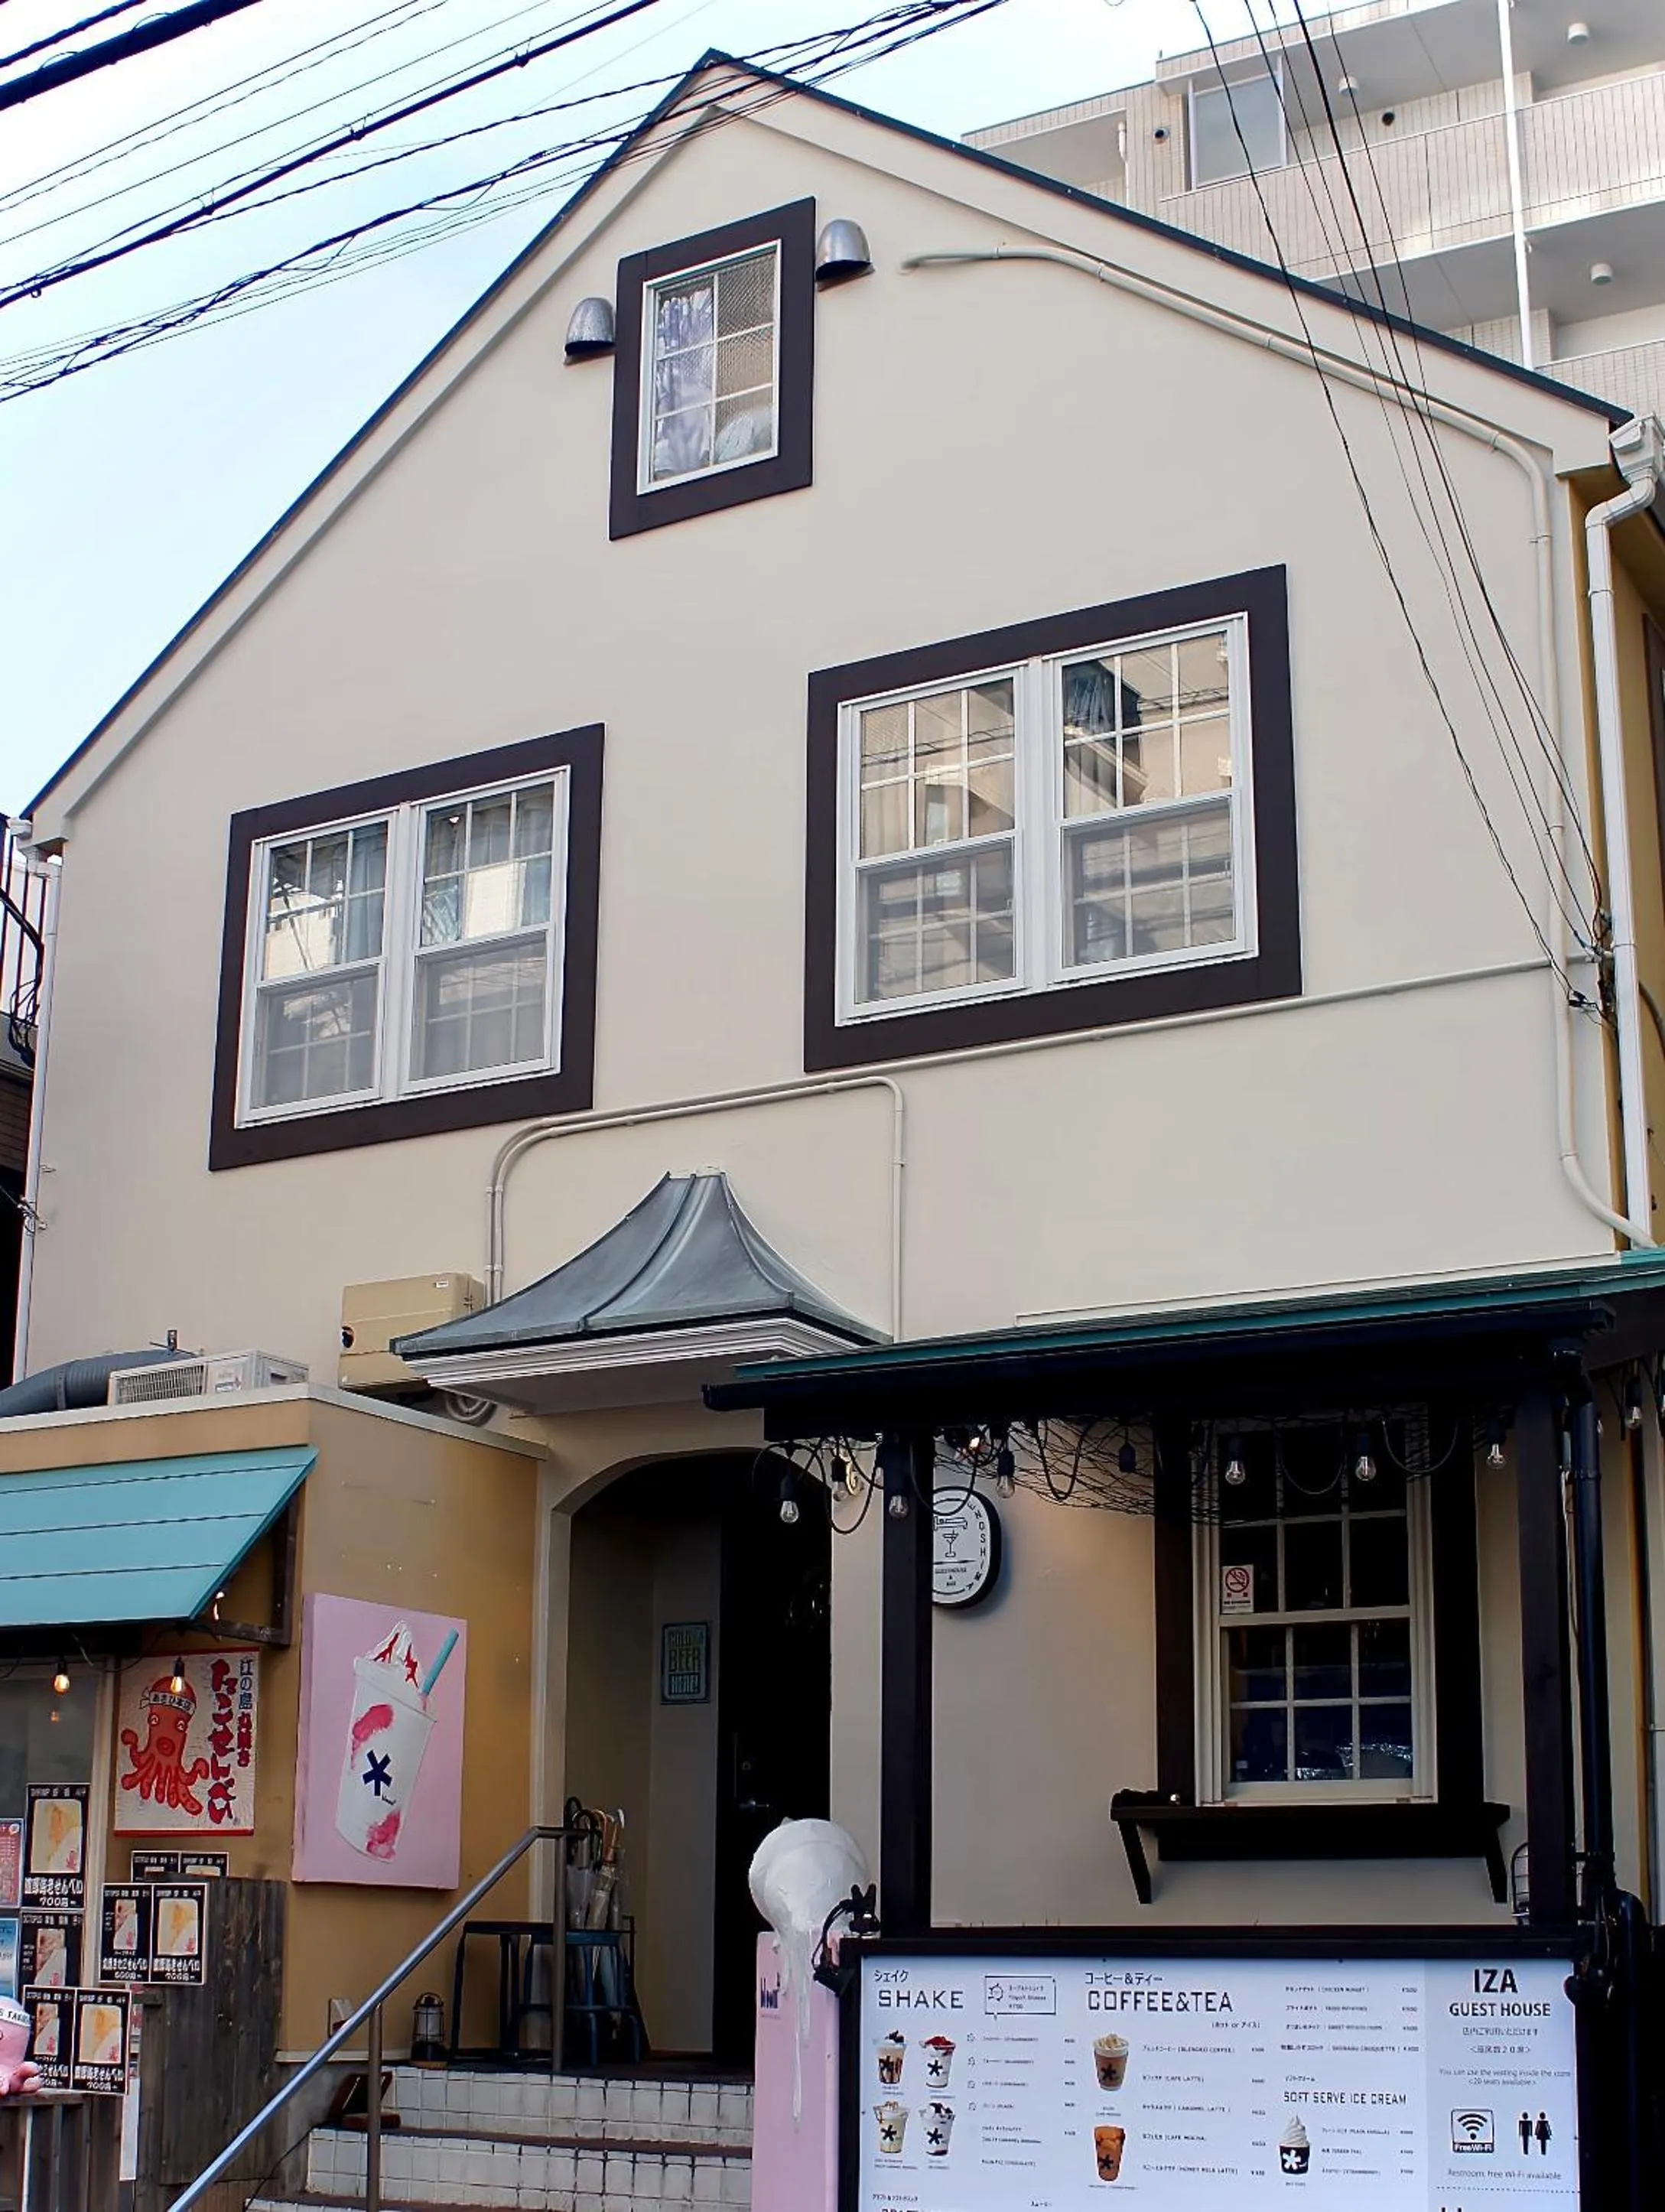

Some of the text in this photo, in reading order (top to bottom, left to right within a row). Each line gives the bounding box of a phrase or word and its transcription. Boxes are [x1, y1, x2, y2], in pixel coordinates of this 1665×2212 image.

[239, 1659, 252, 1709] 江の島
[874, 1970, 909, 1983] シェイク
[1474, 1968, 1518, 1993] IZA
[879, 1990, 964, 2009] SHAKE
[1088, 1990, 1234, 2012] COFFEE&TEA
[1449, 2002, 1551, 2017] GUEST HOUSE
[1283, 2090, 1406, 2105] SOFT SERVE ICE CREAM
